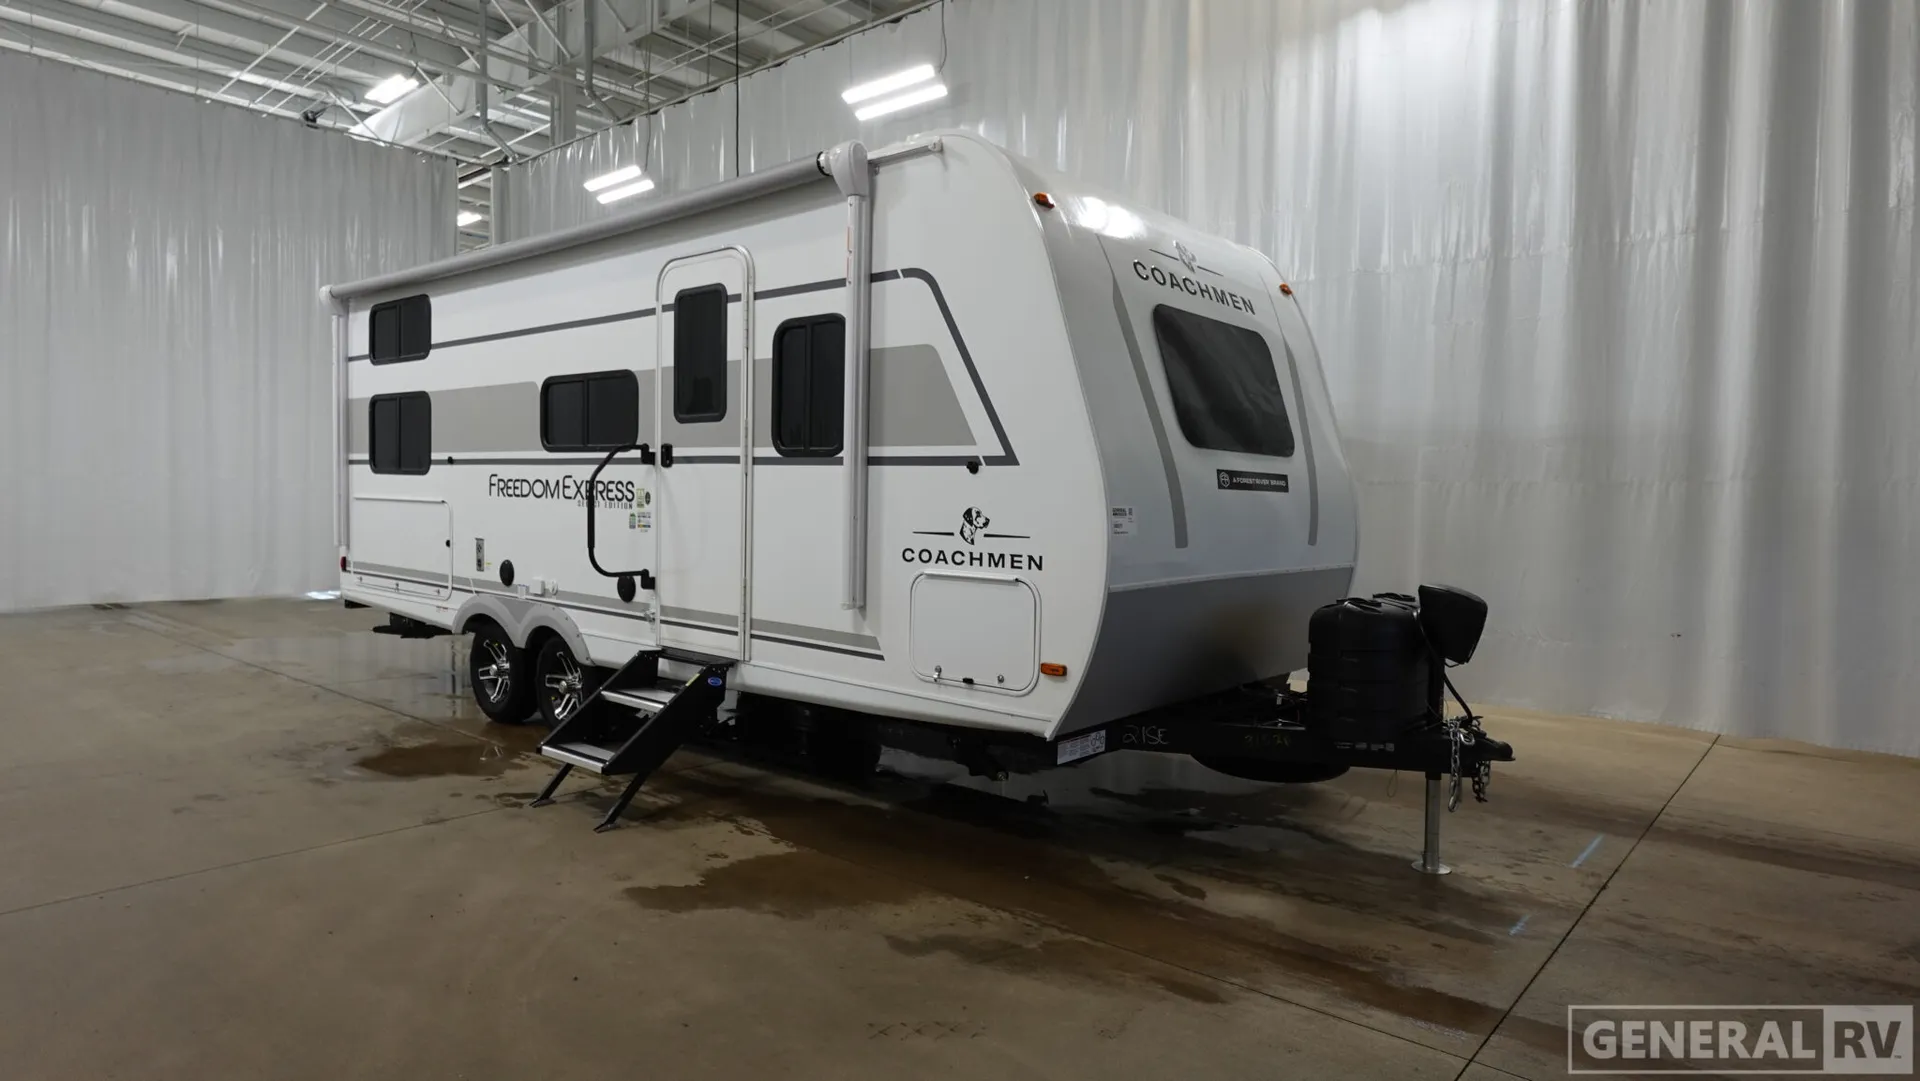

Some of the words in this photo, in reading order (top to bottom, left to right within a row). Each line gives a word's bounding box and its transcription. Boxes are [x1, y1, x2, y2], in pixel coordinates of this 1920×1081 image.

[1132, 259, 1256, 315] COACHMEN
[488, 473, 560, 499] FREEDOM
[605, 501, 632, 510] EDITION
[901, 547, 1043, 571] COACHMEN
